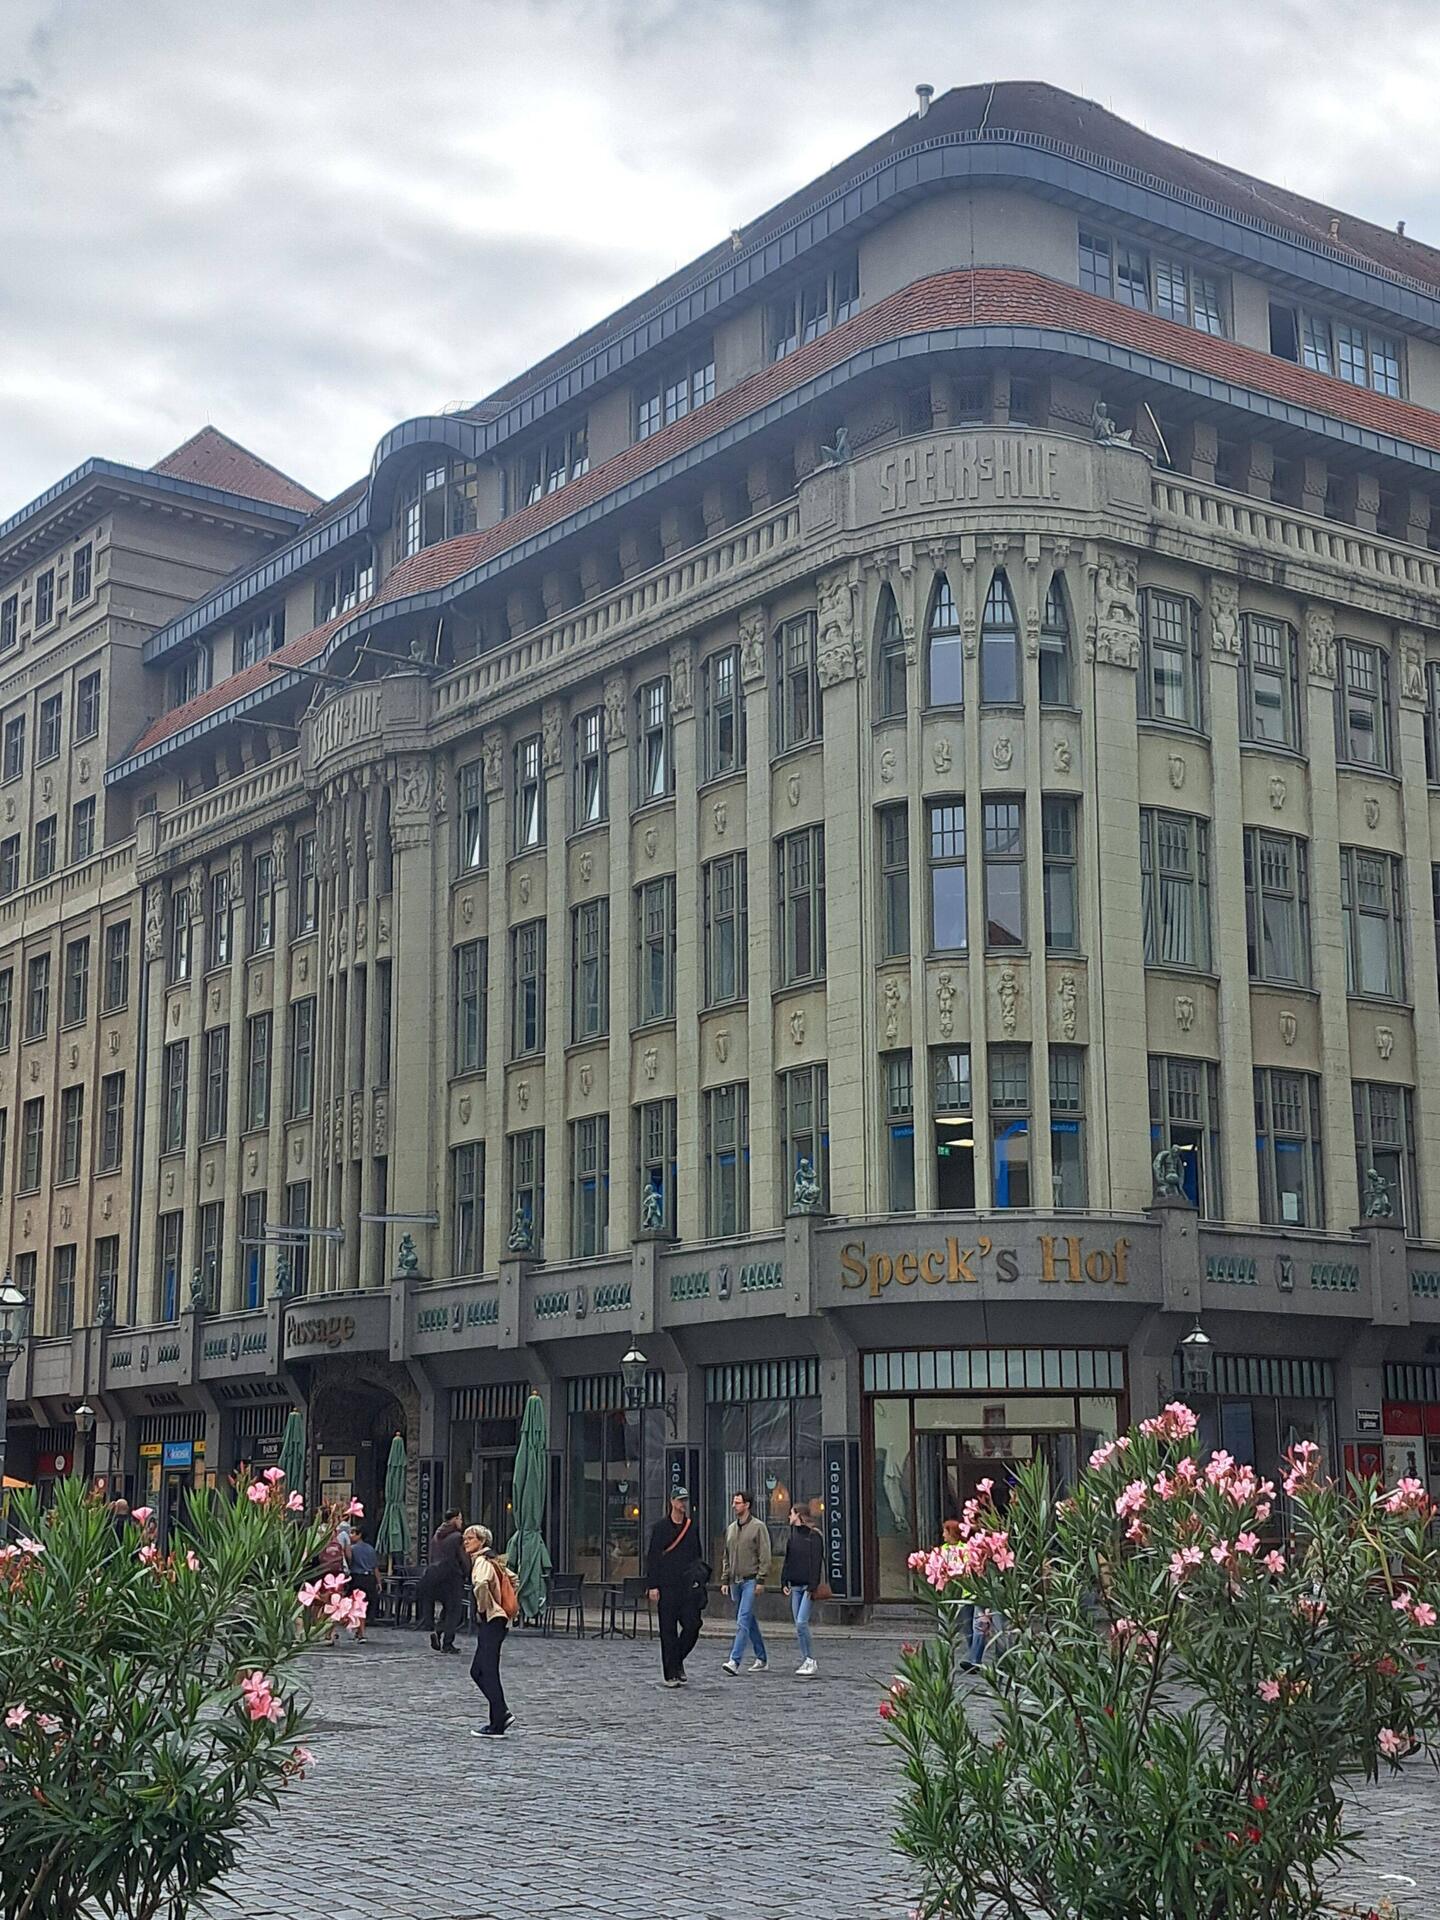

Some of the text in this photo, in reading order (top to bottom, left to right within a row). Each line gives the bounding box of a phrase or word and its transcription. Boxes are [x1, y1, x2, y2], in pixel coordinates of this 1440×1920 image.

[840, 1232, 1132, 1298] Speck's Hof
[287, 1314, 356, 1349] Passage
